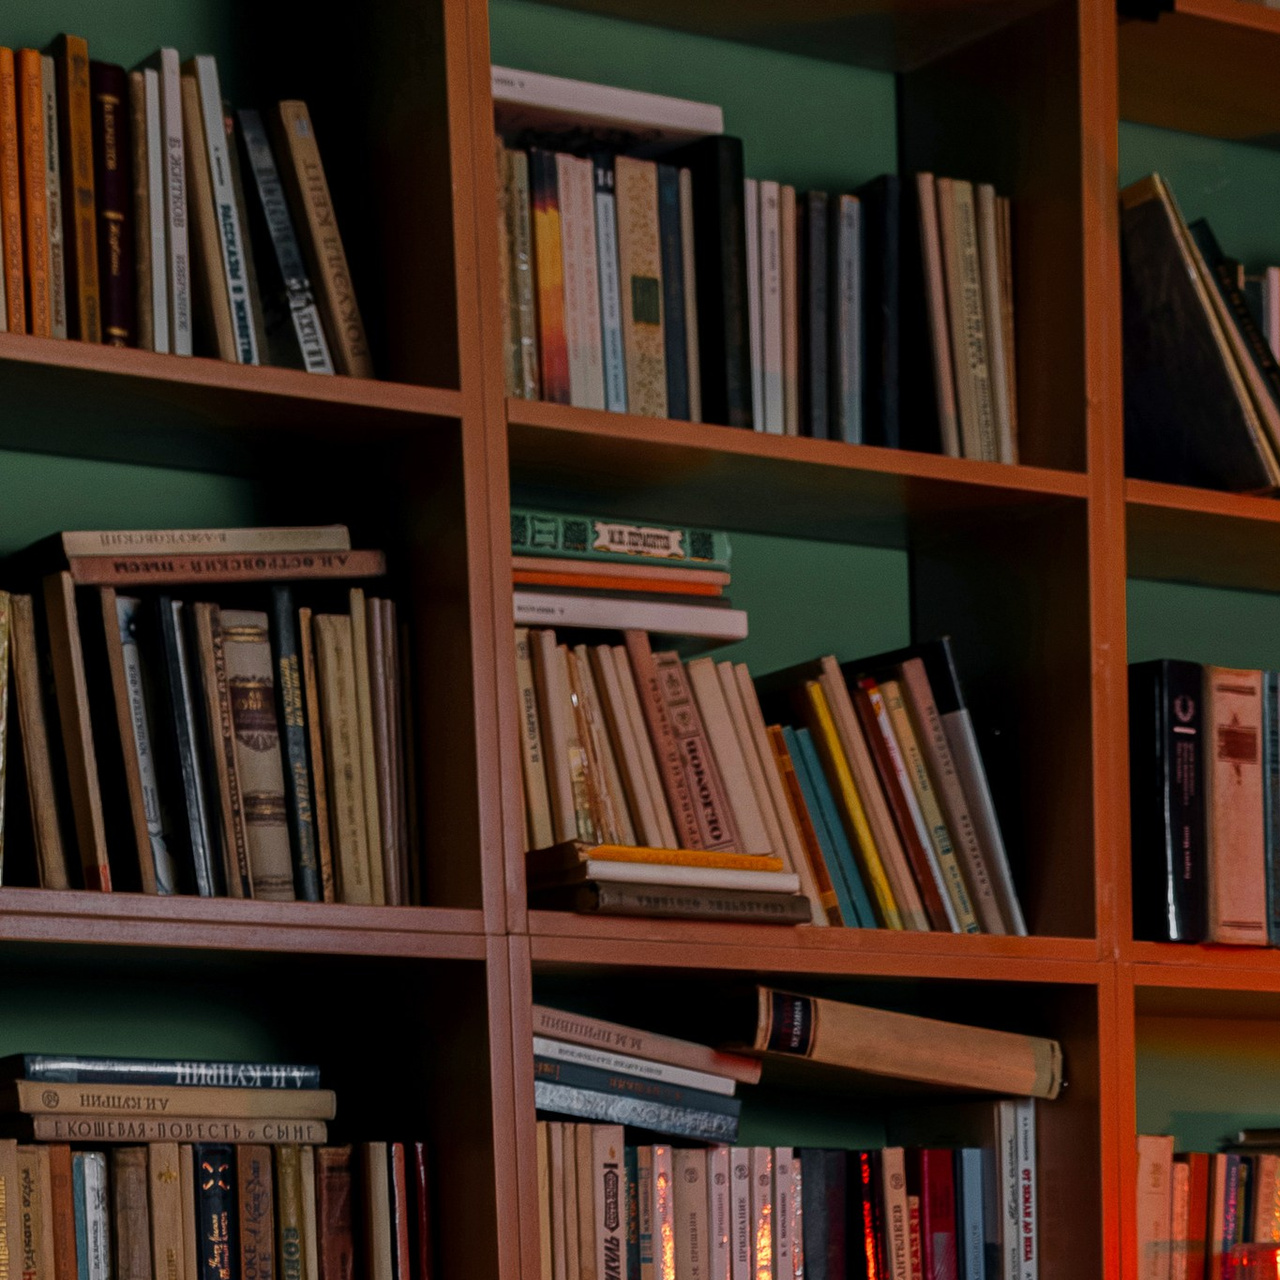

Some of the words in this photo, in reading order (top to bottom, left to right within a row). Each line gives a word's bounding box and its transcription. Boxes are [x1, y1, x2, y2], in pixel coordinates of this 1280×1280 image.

[168, 153, 185, 228] ЖИТКОВ
[303, 158, 334, 228] КЕНТ
[323, 236, 367, 358] РОКУЭЛЛ
[113, 560, 174, 572] ПЬЕСЫ
[189, 556, 313, 572] ОСТРОВСКИЙ
[211, 635, 227, 693] ПОЛКА
[680, 737, 726, 842] ОБЛОМОВ
[539, 1014, 612, 1044] ПРИШВИН
[791, 1001, 801, 1047] БЕРЛИНА
[174, 1062, 262, 1086] КУПРИН
[157, 1122, 240, 1138] ПОВЕСТЬ
[262, 1123, 314, 1138] СЫНЕ
[1021, 1169, 1031, 1180] ОТ
[716, 1192, 724, 1235] ПРИШВИН
[779, 1192, 787, 1239] КОРОЛЕНКО
[1022, 1184, 1031, 1217] ЗЕМЛИ
[688, 1212, 699, 1262] ПРИШВИН
[737, 1197, 747, 1262] ПРИЗНАНИЕ
[1022, 1221, 1032, 1233] ДО
[1023, 1236, 1032, 1261] НЕБА
